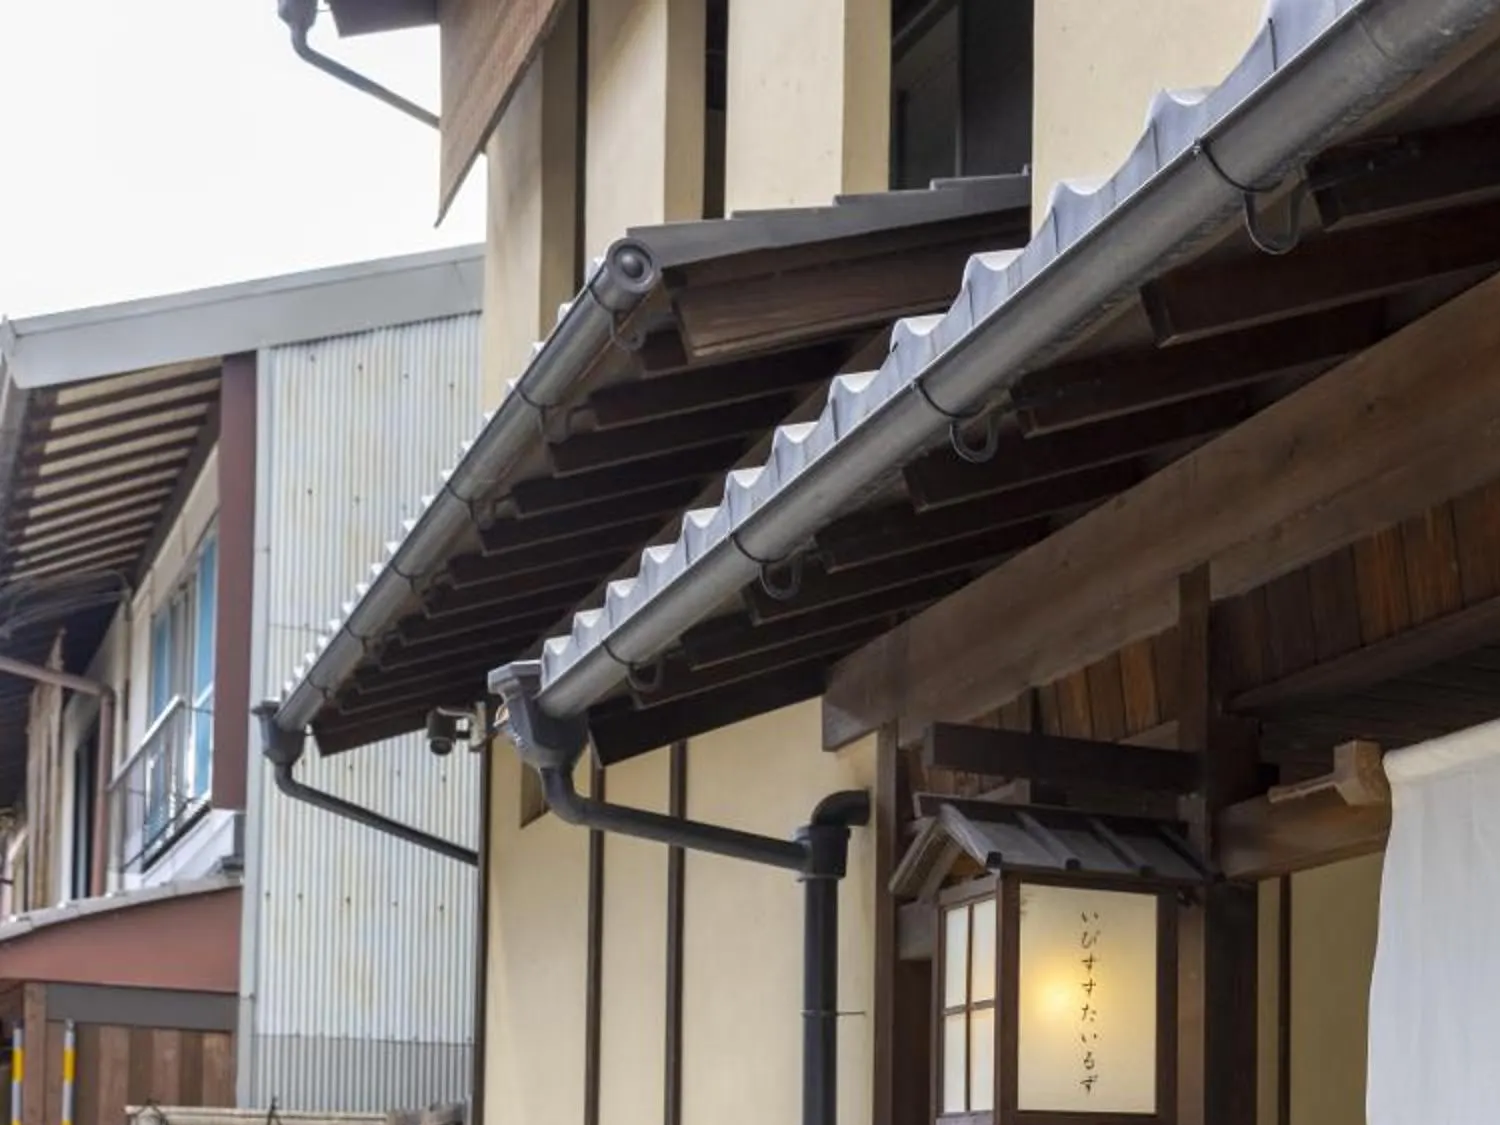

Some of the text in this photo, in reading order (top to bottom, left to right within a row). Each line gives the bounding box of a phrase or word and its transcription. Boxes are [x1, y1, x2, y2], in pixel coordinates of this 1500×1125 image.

[1079, 911, 1101, 1095] いびすすたいるず
